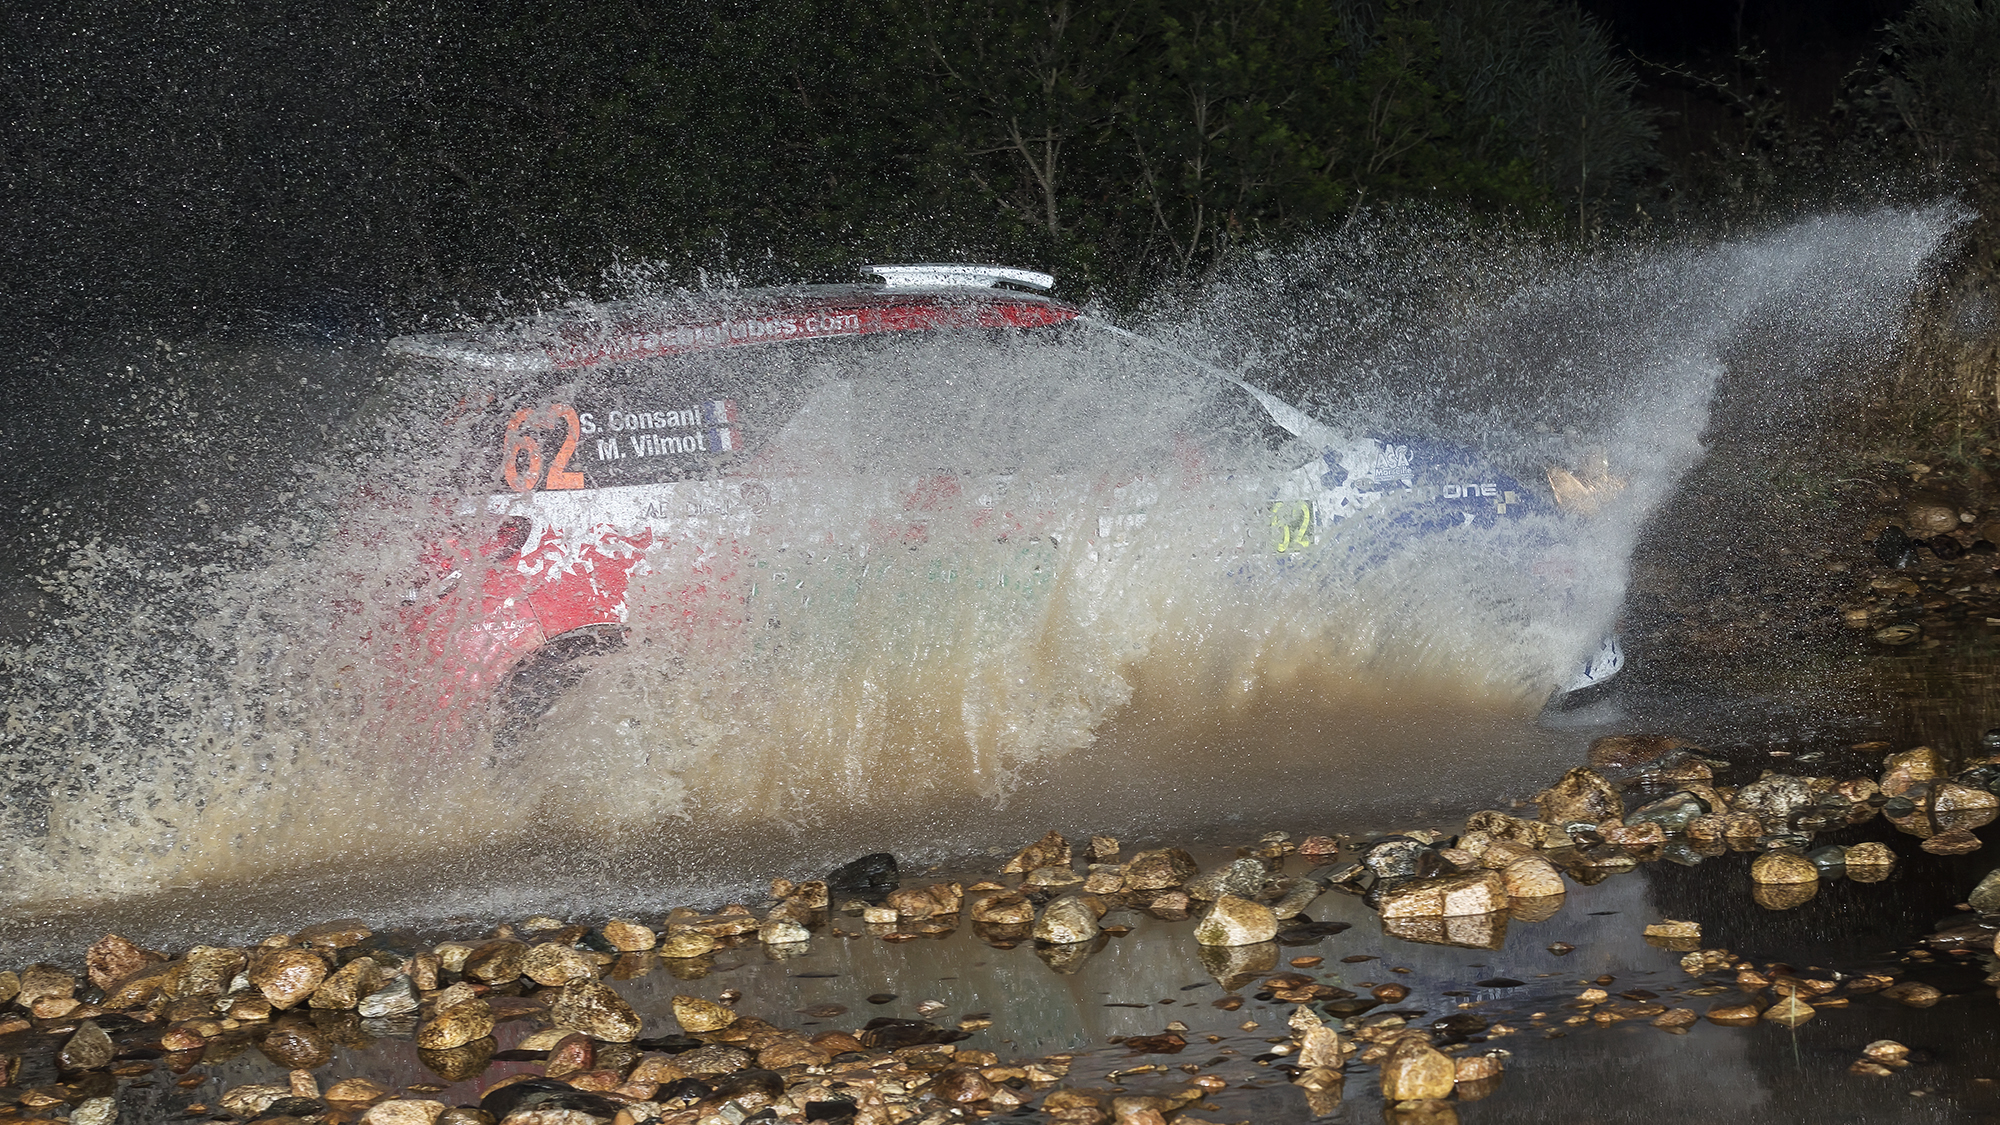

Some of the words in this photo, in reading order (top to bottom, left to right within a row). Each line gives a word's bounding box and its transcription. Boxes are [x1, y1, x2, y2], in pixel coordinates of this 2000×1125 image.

[580, 413, 603, 434] S.
[608, 405, 702, 432] Consani
[504, 403, 585, 491] 62
[597, 439, 626, 461] M.
[630, 432, 706, 458] Vilmot
